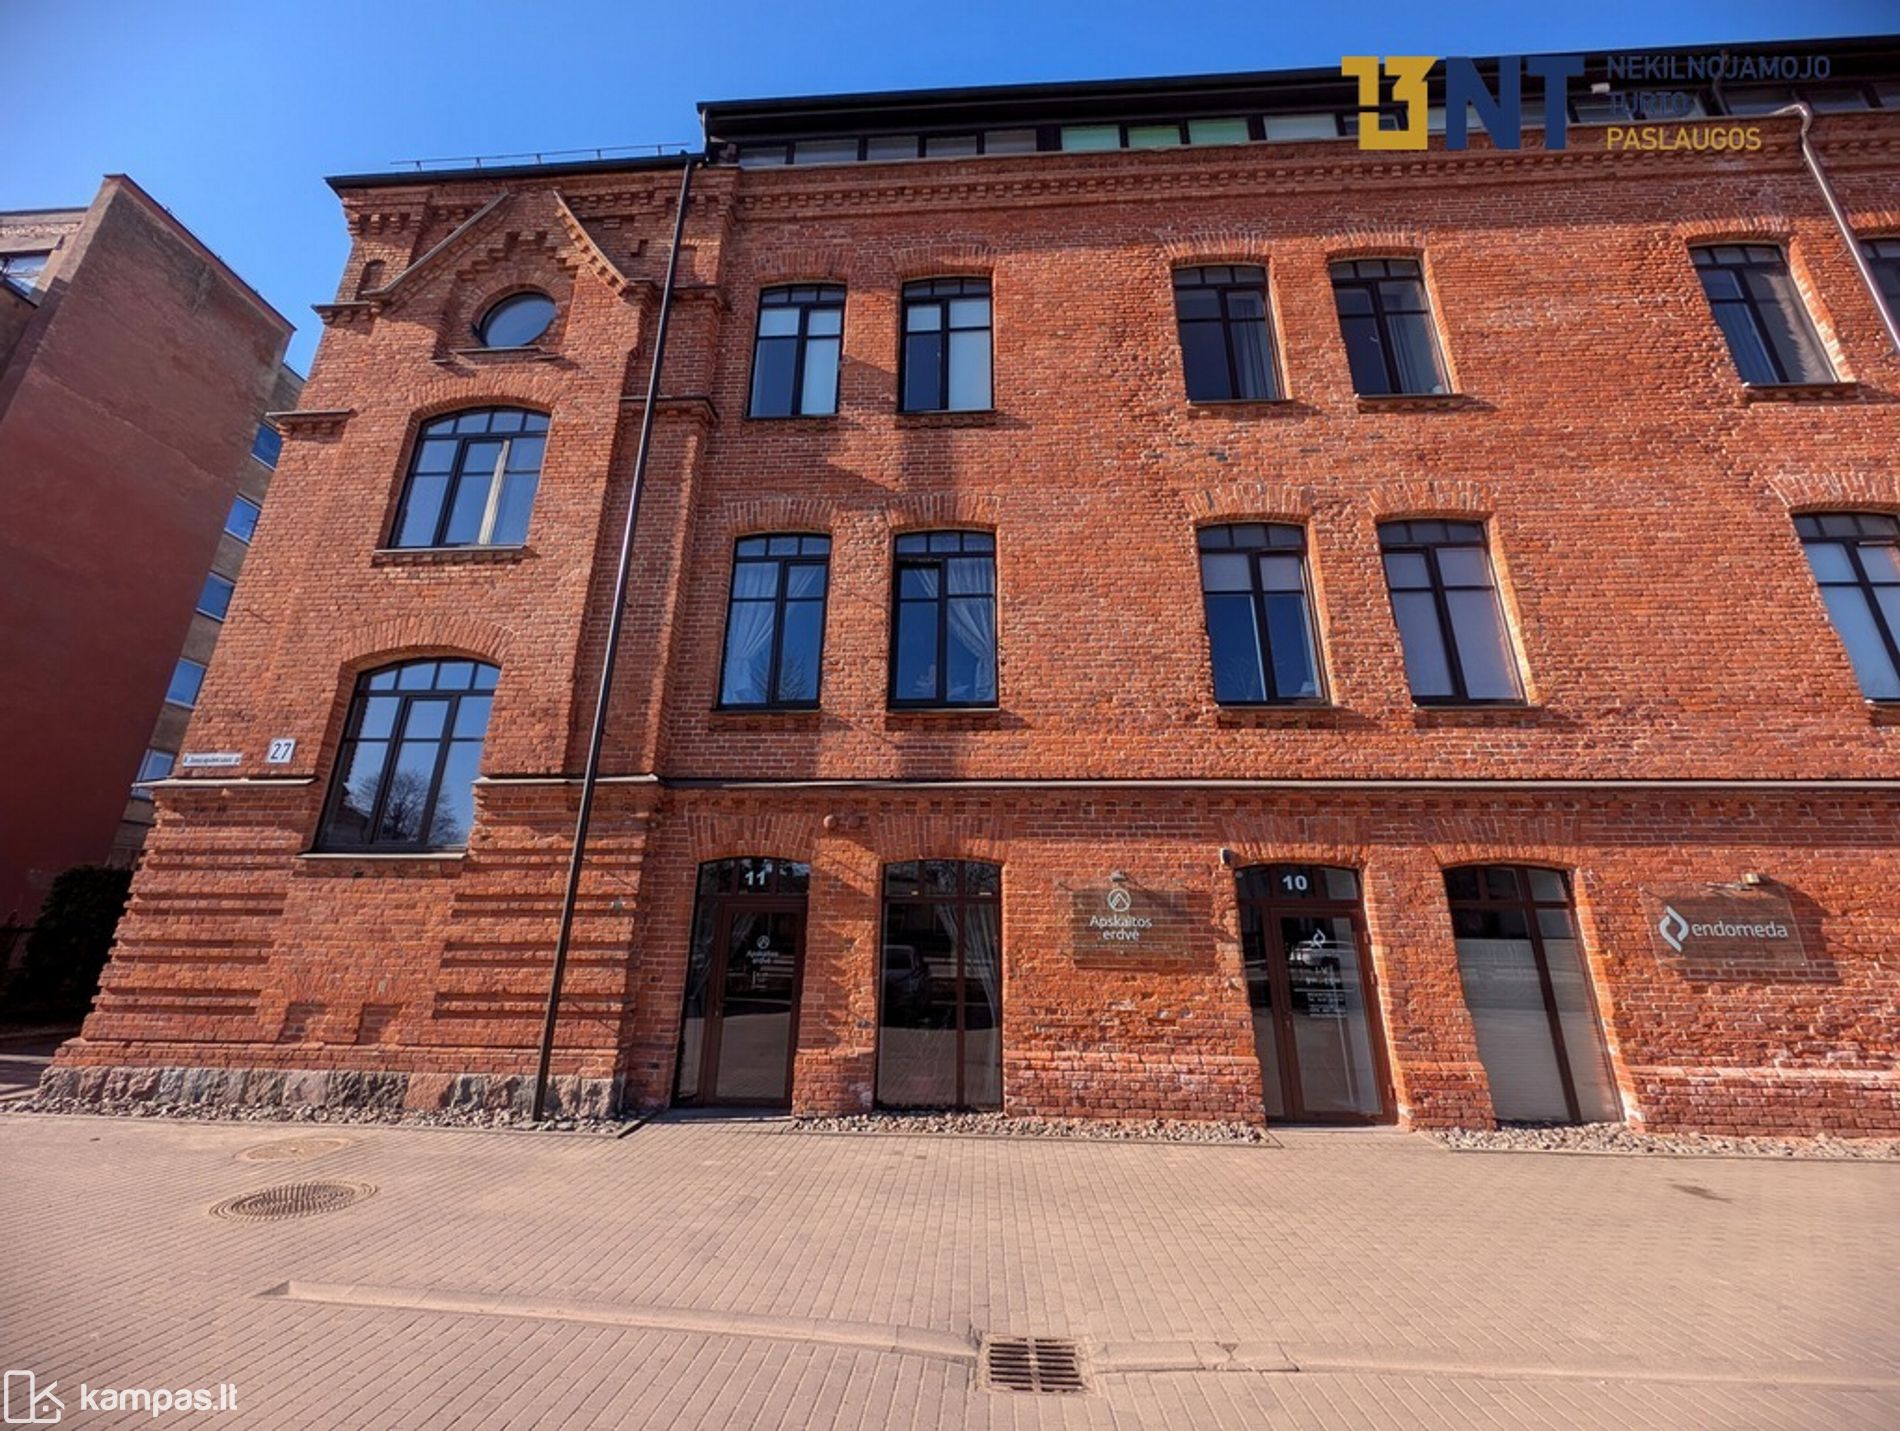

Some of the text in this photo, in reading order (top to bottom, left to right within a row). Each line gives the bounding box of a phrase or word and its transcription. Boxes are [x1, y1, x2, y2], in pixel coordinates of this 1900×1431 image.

[270, 742, 292, 760] 27
[744, 871, 767, 886] 11
[1282, 874, 1308, 891] 10
[1089, 914, 1153, 929] Apskaitos
[1691, 920, 1789, 938] endomeda
